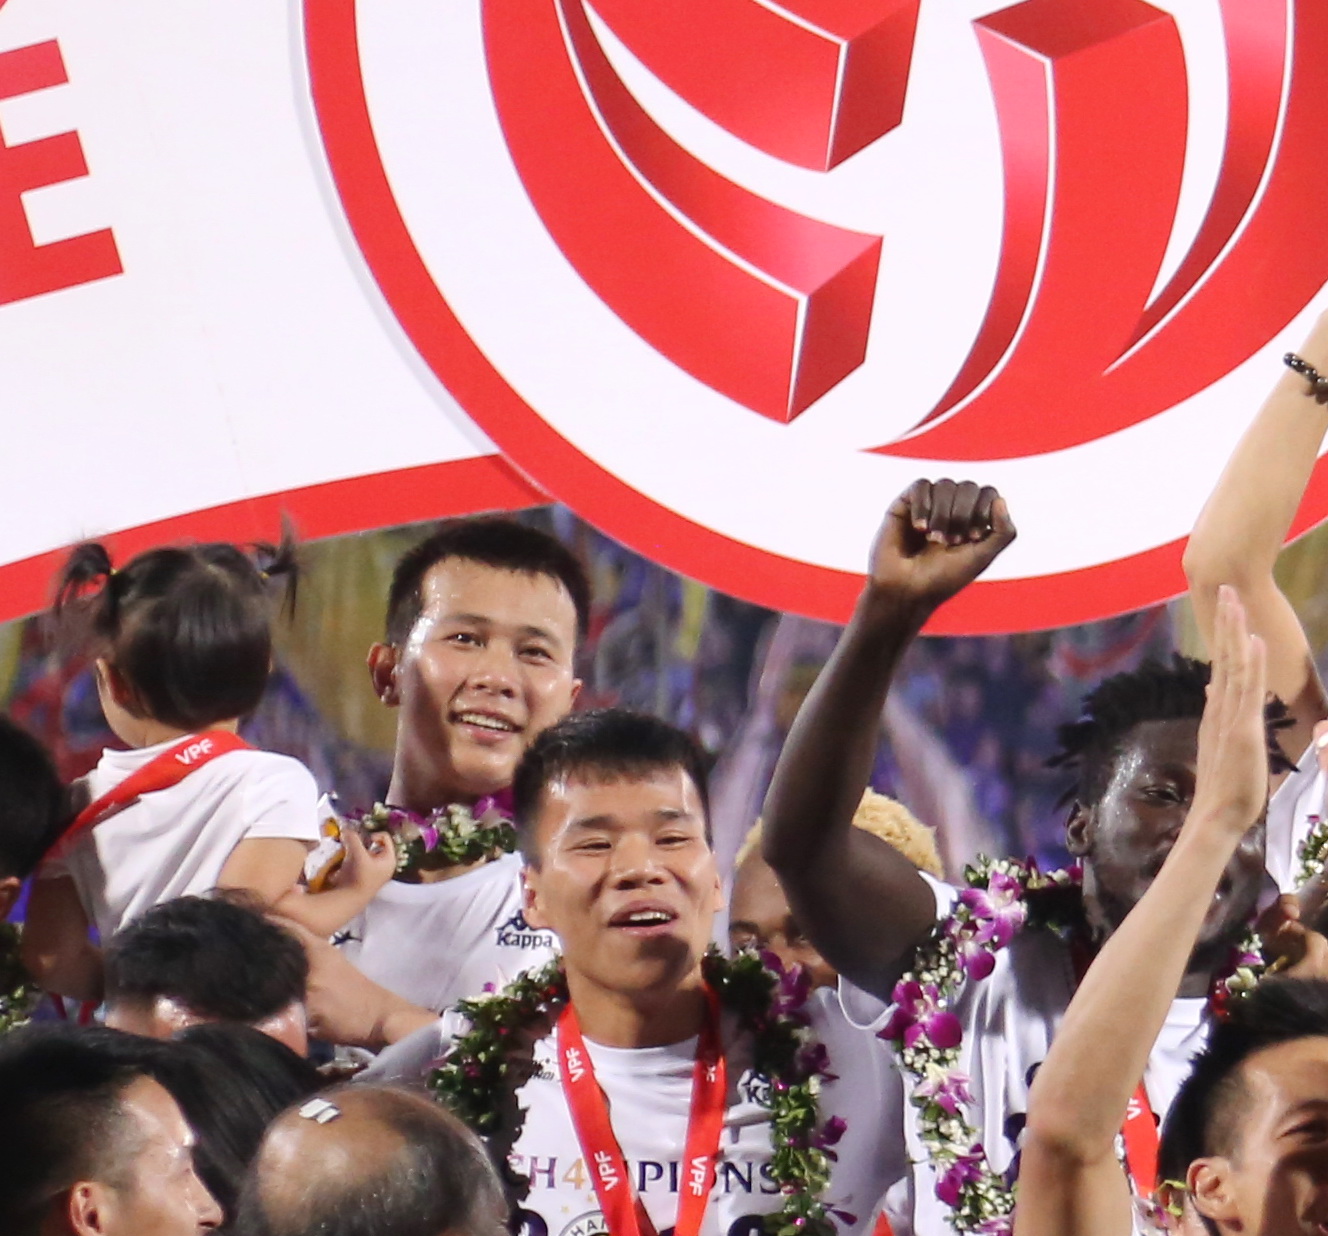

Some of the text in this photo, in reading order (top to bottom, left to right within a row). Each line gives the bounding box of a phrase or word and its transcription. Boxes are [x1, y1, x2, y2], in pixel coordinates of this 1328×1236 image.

[174, 738, 214, 765] VPF
[496, 929, 553, 950] Kappa
[566, 1047, 583, 1083] VPF
[594, 1151, 619, 1191] VPF
[689, 1156, 708, 1196] VPF
